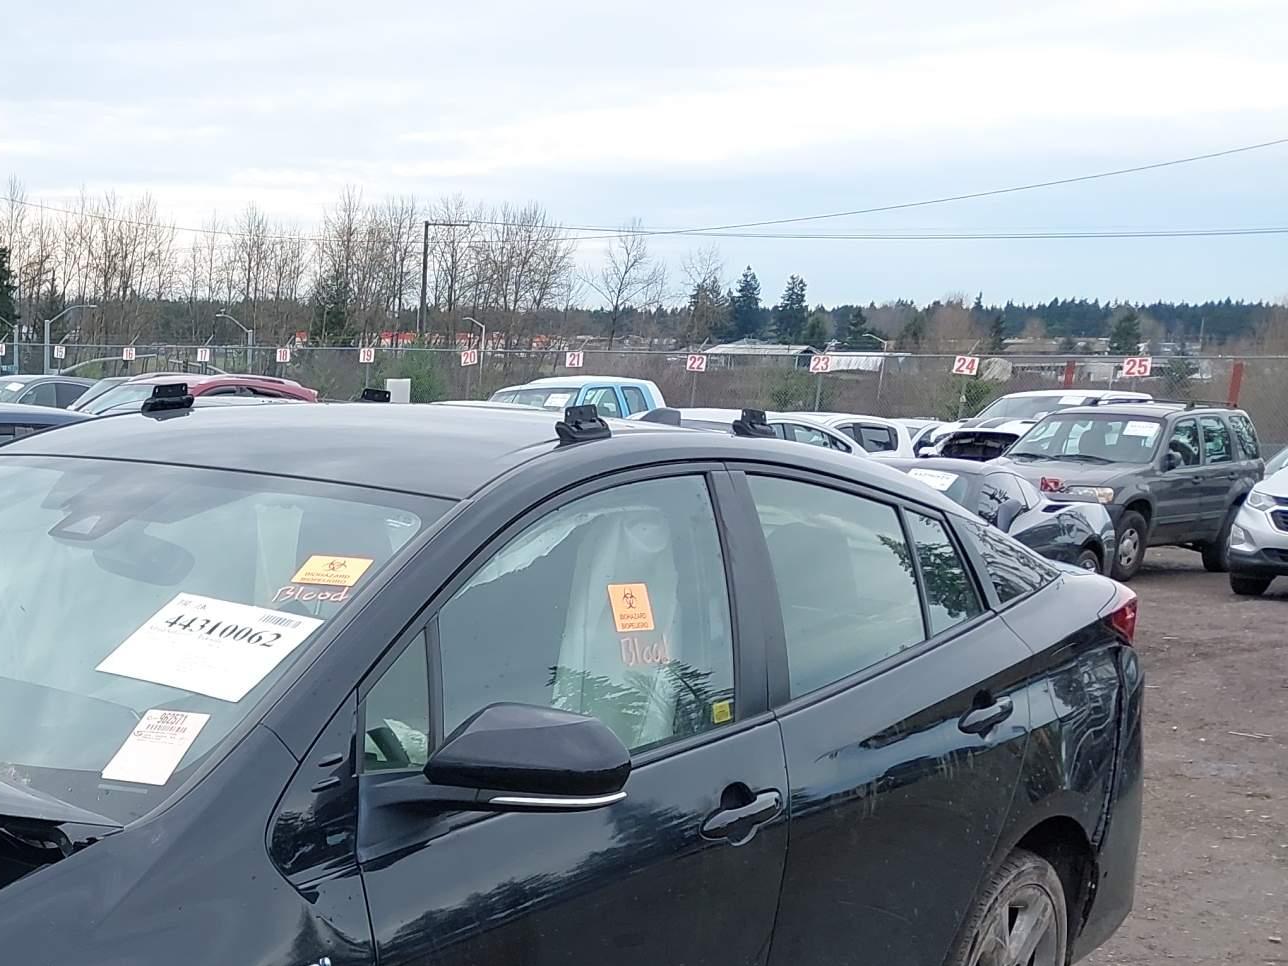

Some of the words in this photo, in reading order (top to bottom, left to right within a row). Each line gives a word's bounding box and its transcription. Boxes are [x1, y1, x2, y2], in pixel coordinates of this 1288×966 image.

[362, 350, 372, 362] 19
[463, 351, 476, 365] 20
[569, 353, 581, 367] 21
[688, 355, 705, 370] 22
[813, 356, 830, 372] 23
[955, 357, 976, 373] 24
[1125, 359, 1149, 376] 25
[165, 614, 282, 648] 44310062
